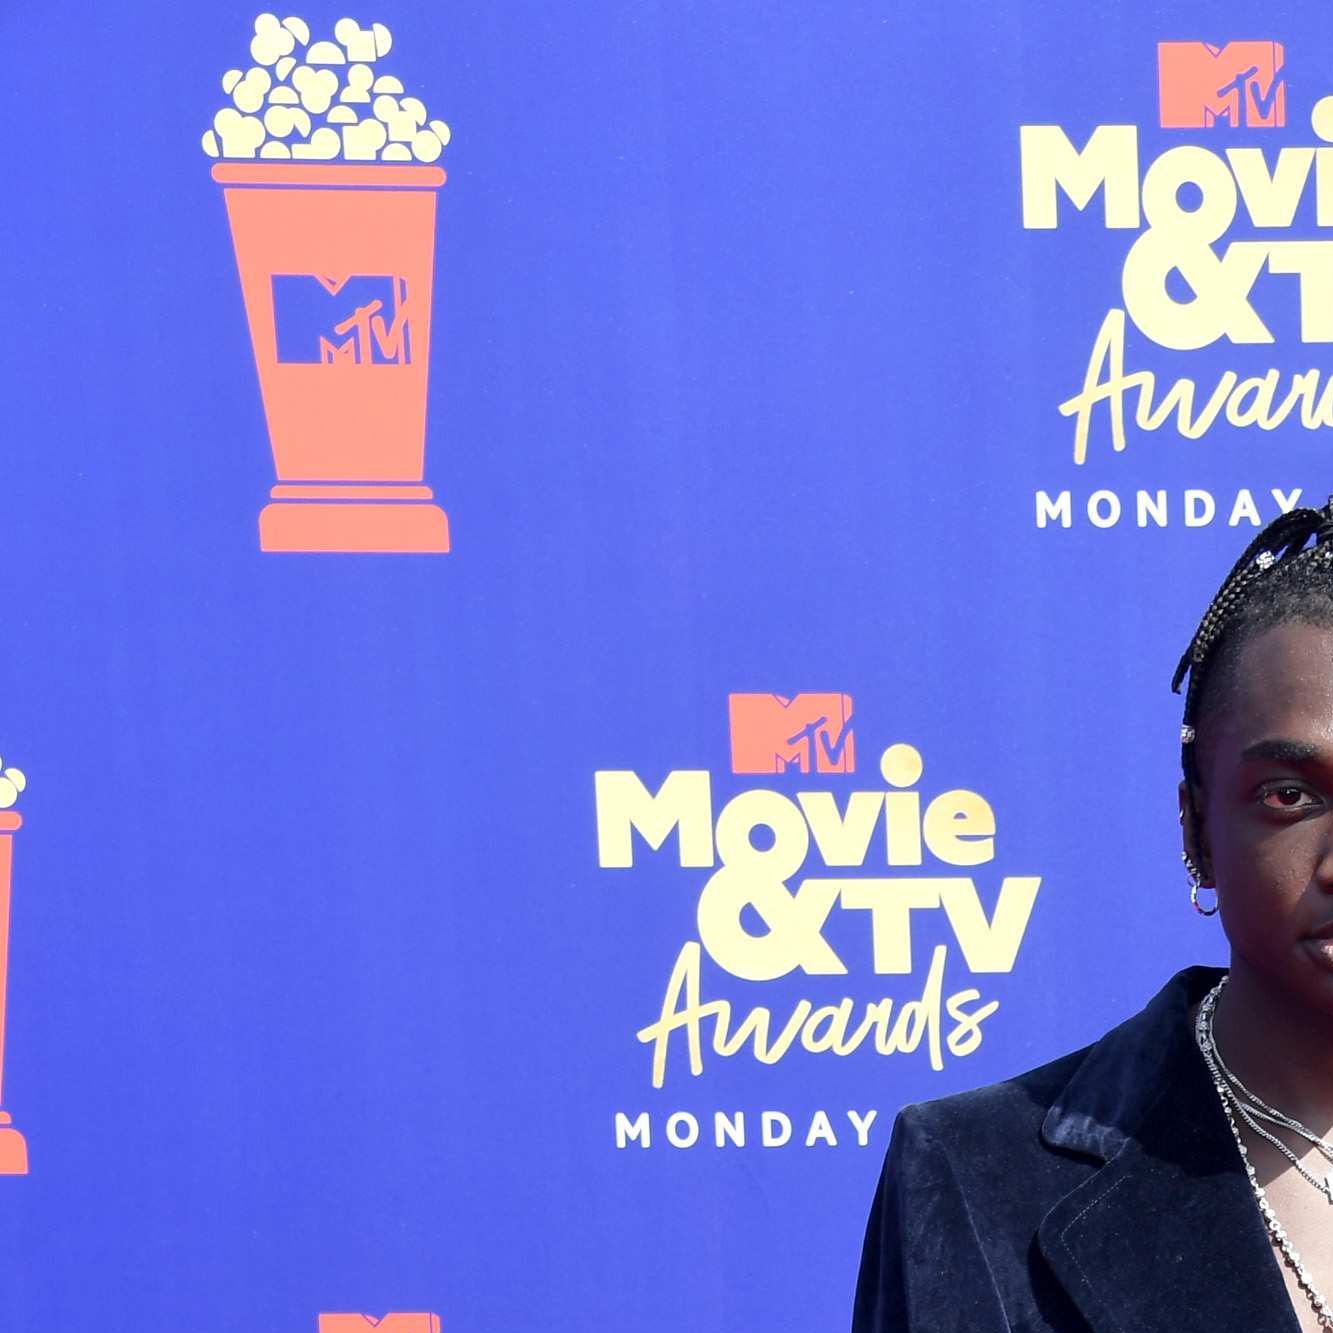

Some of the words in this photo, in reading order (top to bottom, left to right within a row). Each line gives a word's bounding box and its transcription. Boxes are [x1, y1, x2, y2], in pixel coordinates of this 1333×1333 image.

[1158, 41, 1285, 128] MTV
[270, 274, 411, 364] MTV
[729, 693, 854, 773] MTV
[595, 743, 996, 868] Movie
[637, 941, 999, 1089] Awards
[615, 1111, 877, 1149] MONDAY
